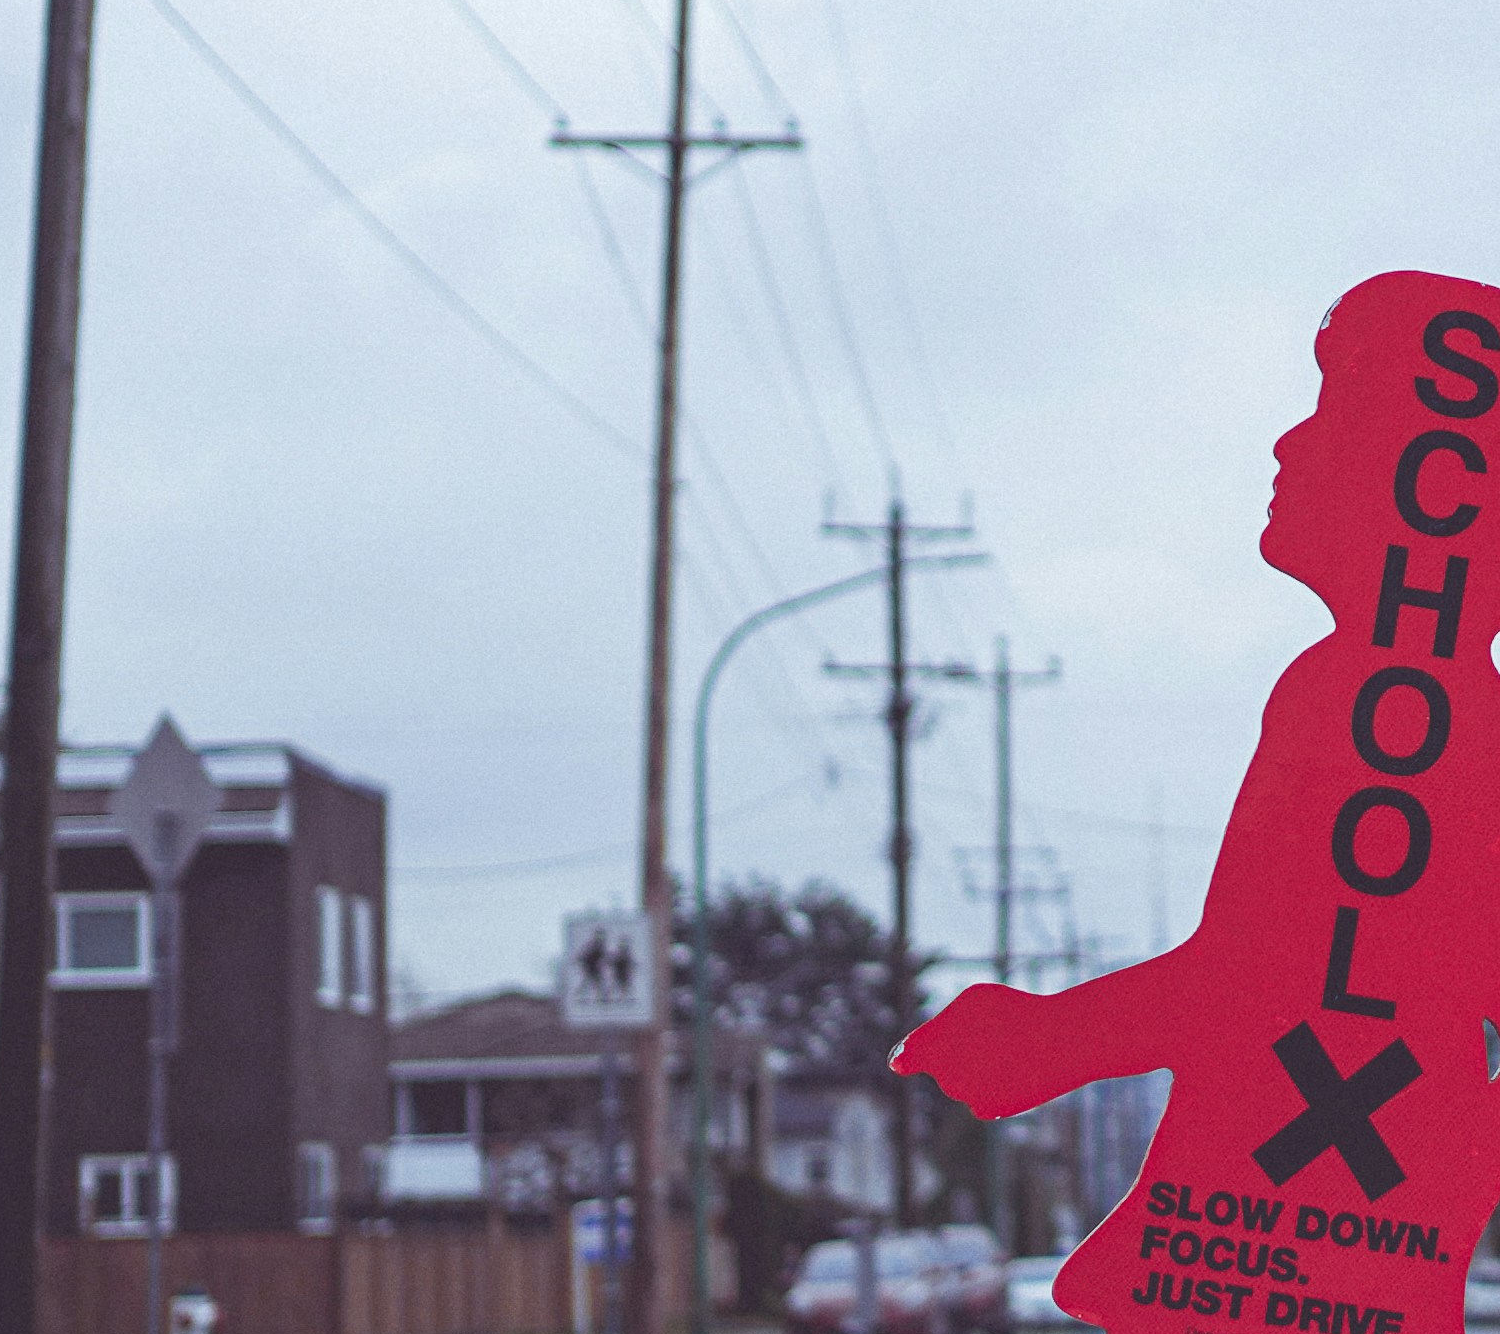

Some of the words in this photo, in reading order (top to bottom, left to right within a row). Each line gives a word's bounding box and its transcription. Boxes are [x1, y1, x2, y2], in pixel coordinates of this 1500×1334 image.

[1147, 1182, 1284, 1233] SLOW
[1295, 1205, 1449, 1262] DOWN.
[1140, 1225, 1309, 1284] FOCUS.
[1132, 1272, 1253, 1320] JUST
